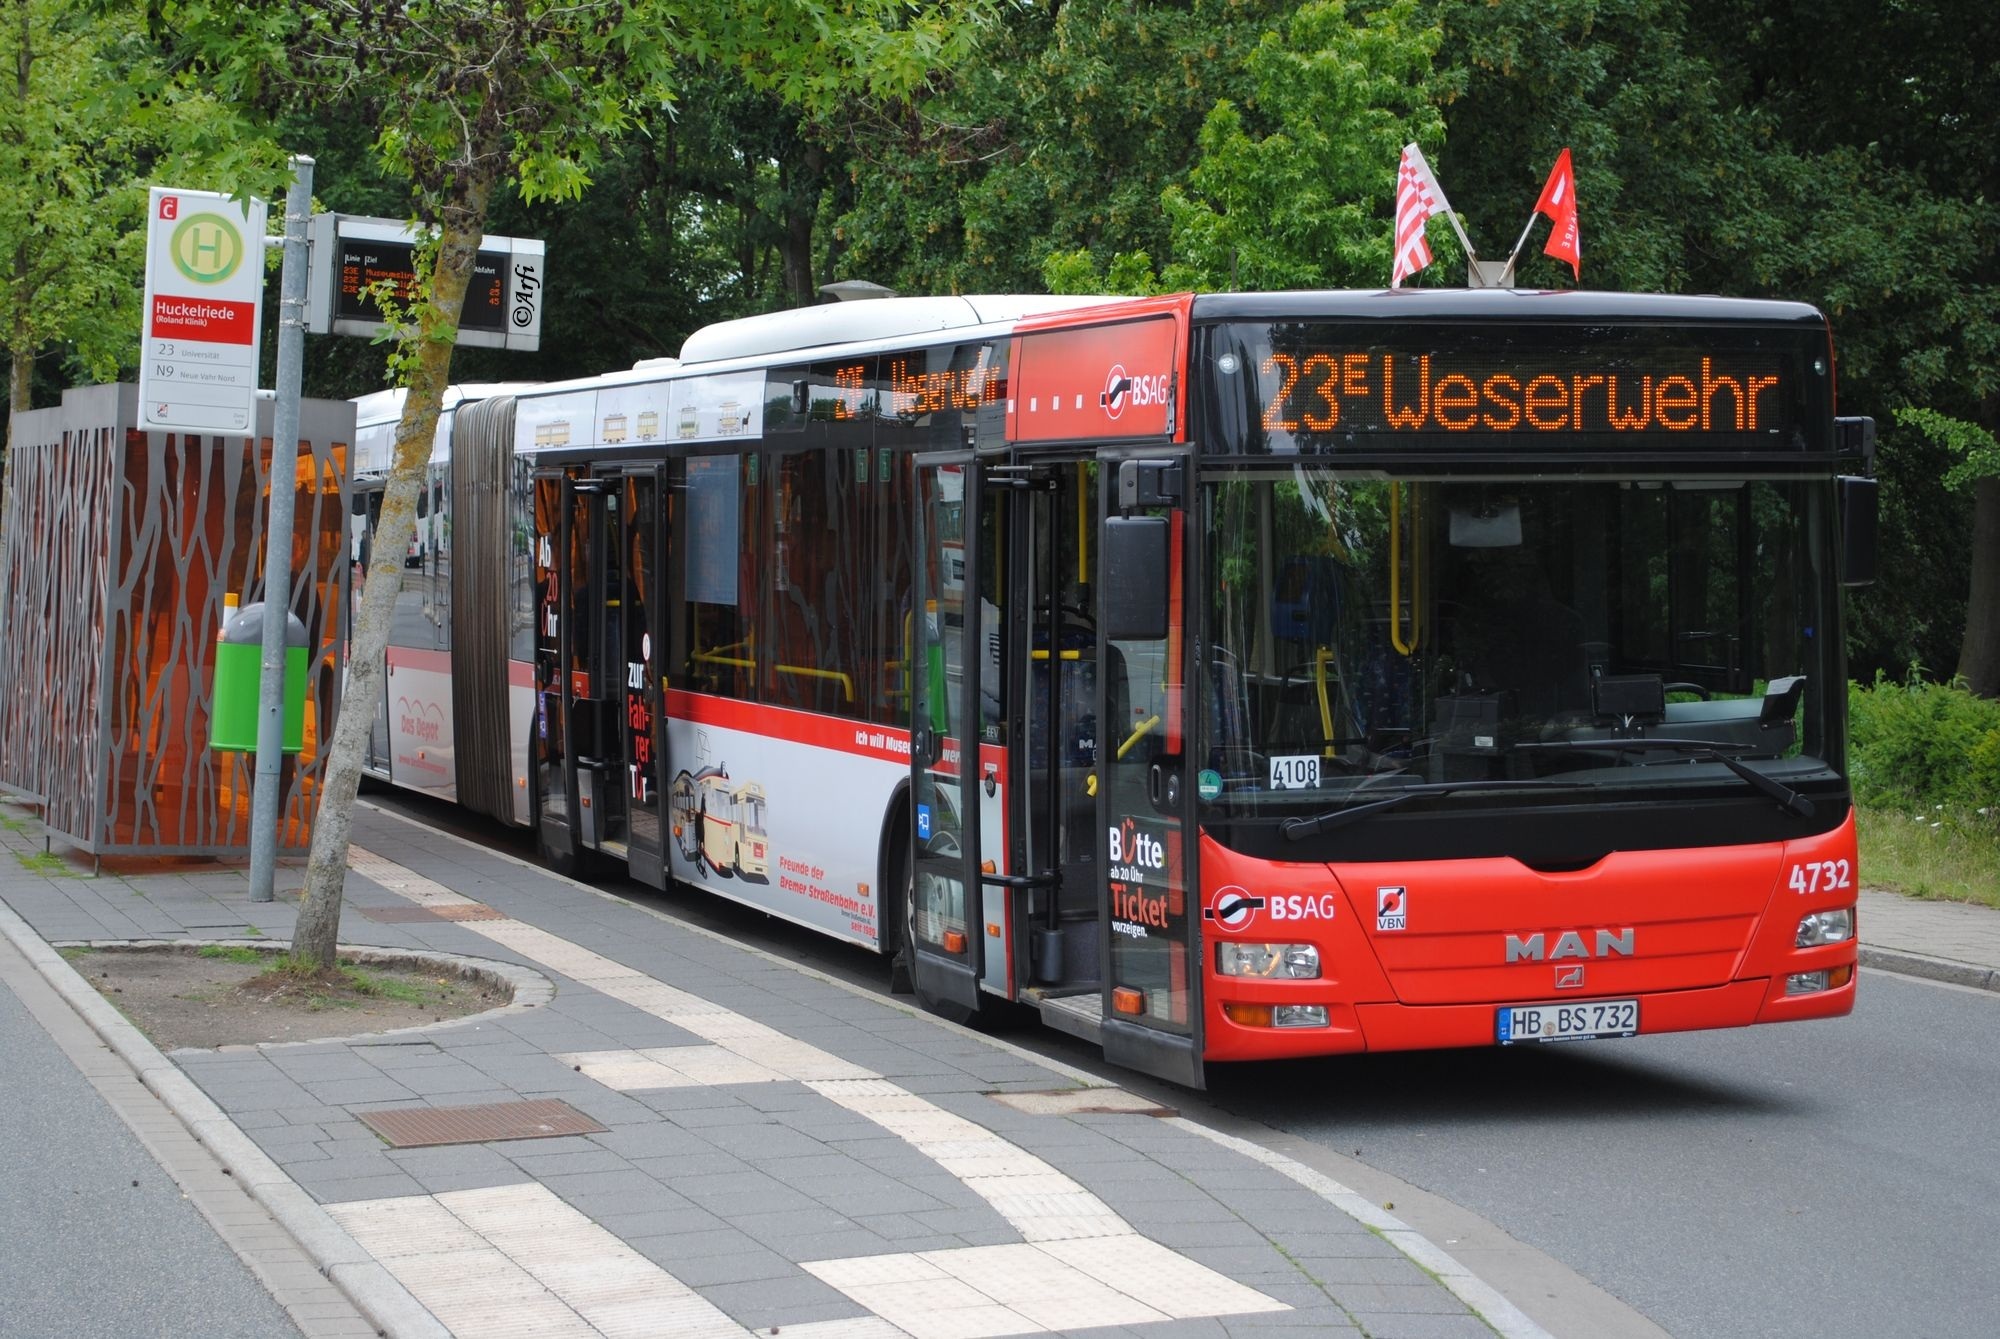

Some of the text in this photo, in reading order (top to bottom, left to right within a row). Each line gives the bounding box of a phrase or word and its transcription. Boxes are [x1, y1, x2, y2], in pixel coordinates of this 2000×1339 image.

[162, 203, 174, 218] C
[191, 227, 222, 269] H
[365, 268, 417, 279] Museumslin
[474, 265, 496, 275] Abfahrt
[155, 315, 208, 327] (Roland Klinik)
[156, 301, 235, 320] Huckelriede
[158, 343, 220, 360] 23 Universität
[156, 364, 236, 383] N9 Neue Vahr Nord
[1132, 374, 1167, 406] BSAG
[1384, 354, 1779, 431] Weserwehr
[538, 535, 552, 568] Ab
[546, 572, 558, 602] 20
[628, 662, 644, 690] zur
[628, 693, 650, 731] Fah-
[986, 725, 1000, 739] EEV
[635, 735, 650, 763] rer
[855, 730, 961, 762] Ich will Muse wer
[1273, 759, 1318, 784] 4108
[779, 855, 825, 881] Freunde der
[1110, 865, 1120, 880] ab
[1120, 867, 1130, 881] 20
[1788, 858, 1851, 895] 4732
[779, 875, 876, 919] Bremer Straßenbahn e.V.
[1110, 883, 1169, 929] Ticket
[1270, 894, 1335, 921] BSAG
[850, 920, 863, 933] seit
[1111, 920, 1148, 939] vorzeigen.
[1378, 917, 1406, 929] VBN
[1505, 927, 1635, 963] MAN
[1512, 1010, 1542, 1036] HB
